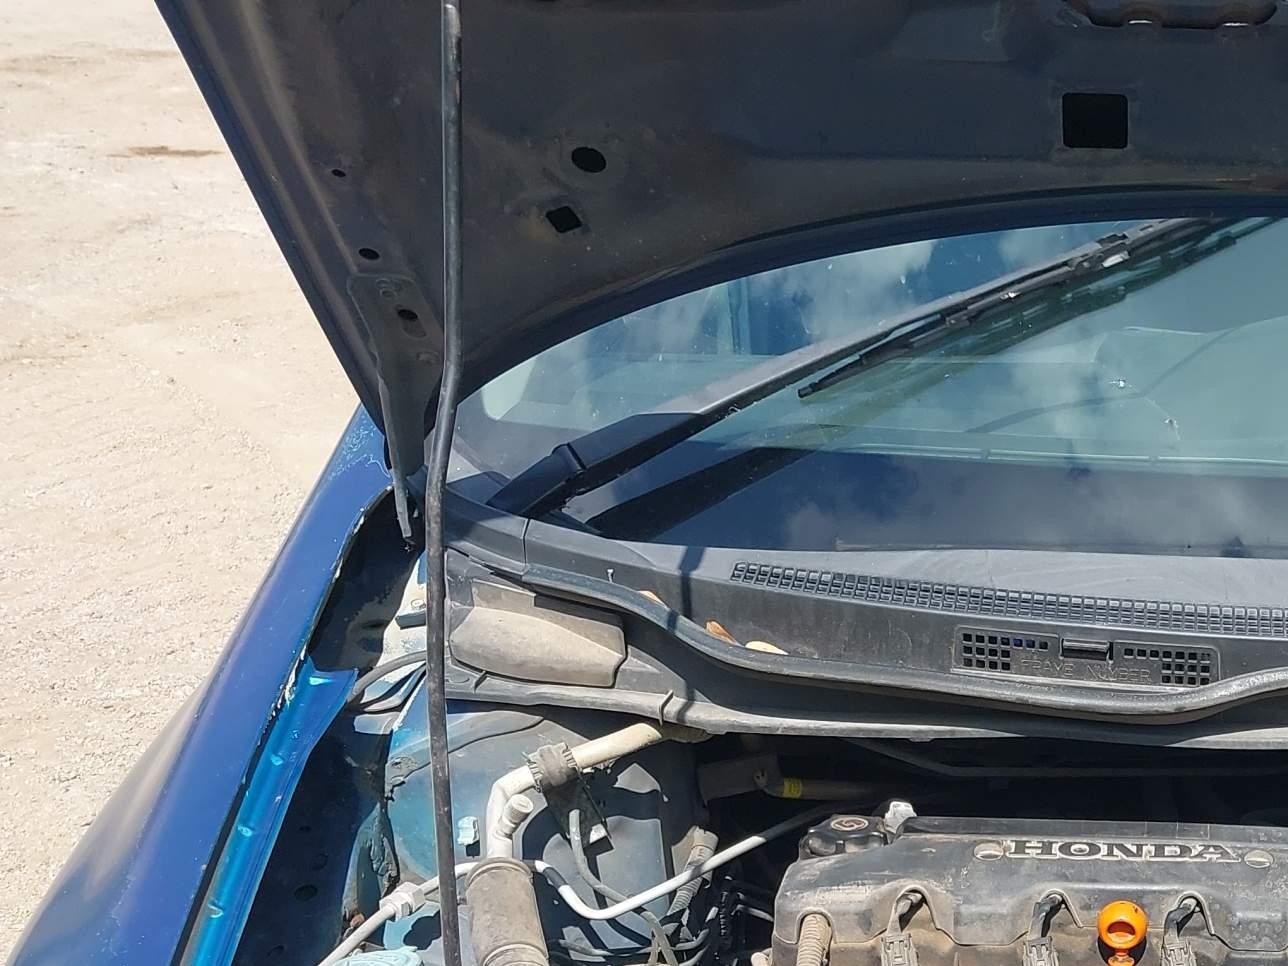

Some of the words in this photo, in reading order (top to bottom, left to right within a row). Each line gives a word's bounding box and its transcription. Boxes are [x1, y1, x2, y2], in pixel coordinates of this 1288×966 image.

[1020, 657, 1074, 675] FRAME
[1084, 663, 1150, 683] NUMBER
[1005, 839, 1240, 863] HONDA
